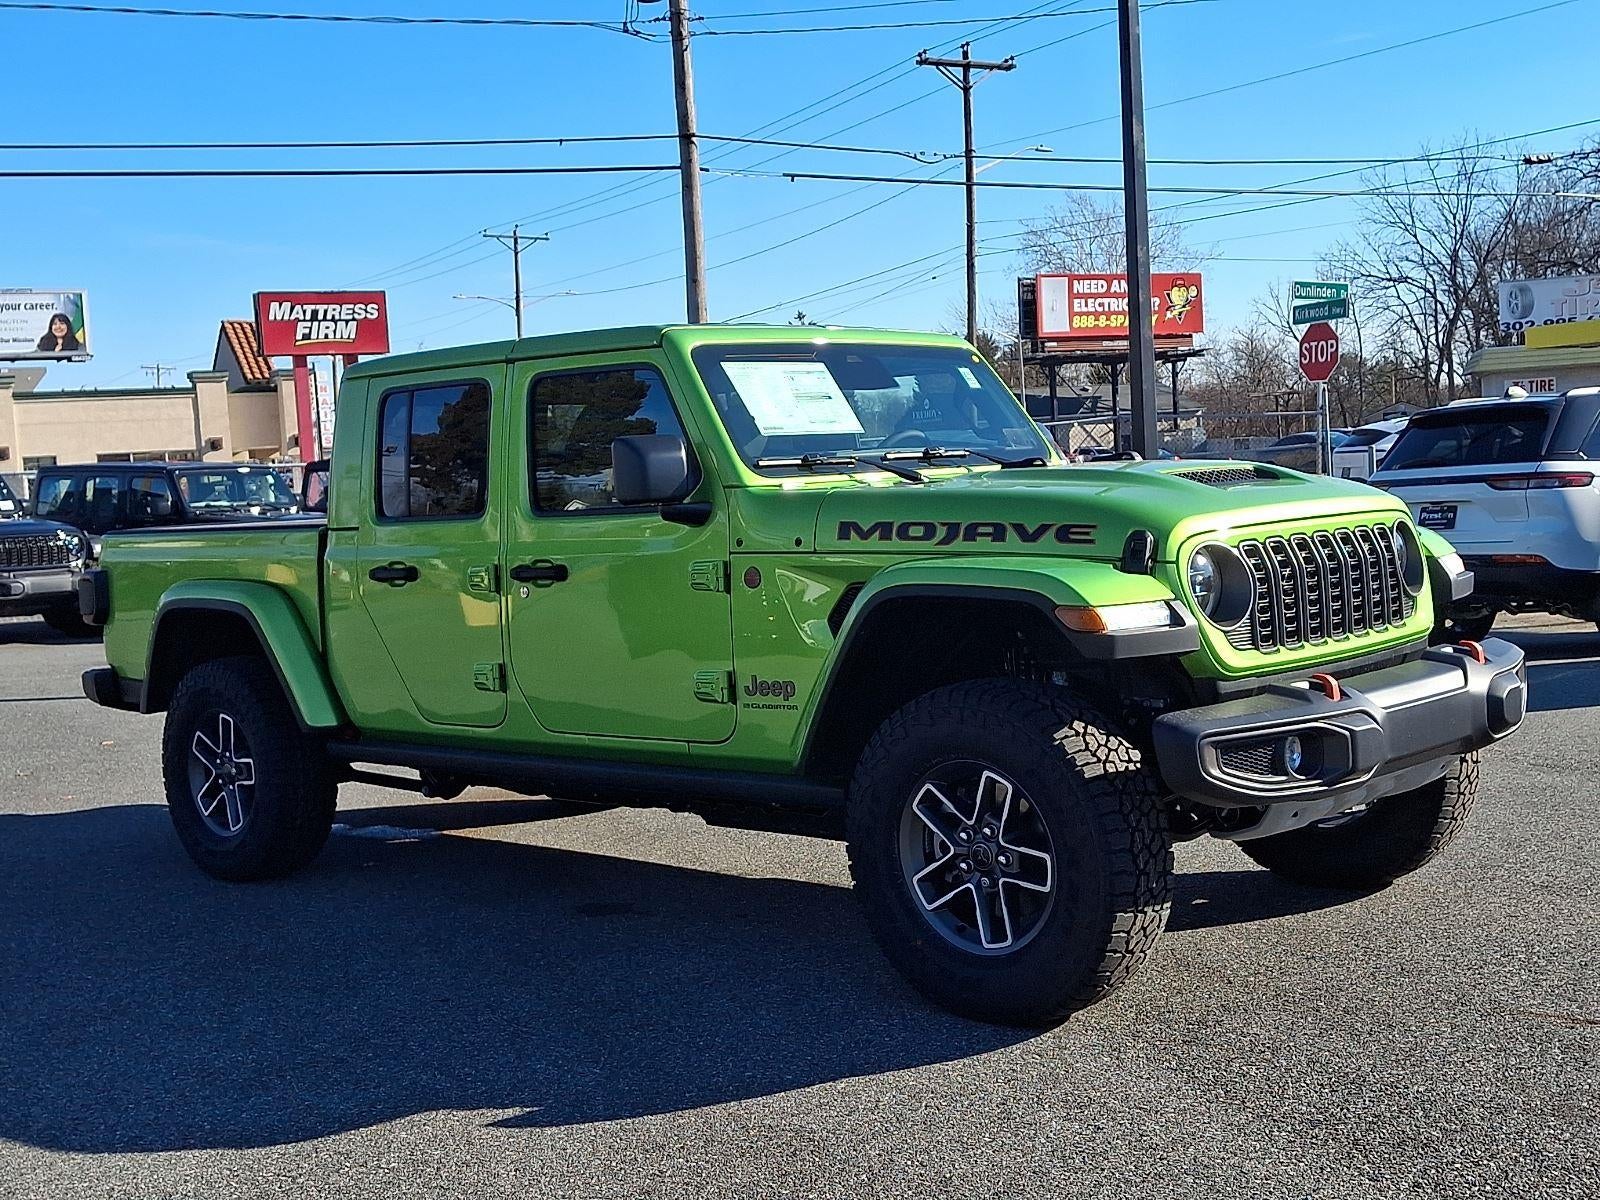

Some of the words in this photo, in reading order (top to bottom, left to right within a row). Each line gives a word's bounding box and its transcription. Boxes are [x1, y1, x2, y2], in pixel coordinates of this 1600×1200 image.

[1073, 279, 1108, 294] NEED
[1295, 285, 1337, 298] Dunlinden
[1341, 290, 1347, 298] Dr
[0, 302, 21, 313] your
[23, 302, 58, 311] career.
[268, 301, 379, 321] MATTRESS
[1073, 297, 1161, 312] ELECTRIC?
[1295, 304, 1329, 320] Kirkwood
[1331, 306, 1345, 315] Hwy
[1072, 314, 1160, 329] 888-8-SPAY
[295, 321, 358, 340] FIRM
[1301, 339, 1337, 364] STOP
[1528, 379, 1555, 392] TIRE
[319, 385, 332, 444] NAILS
[1421, 511, 1454, 520] Preston
[837, 520, 1098, 546] MOJAVE
[743, 674, 796, 701] Jeep
[751, 702, 799, 711] GLADIATOR
